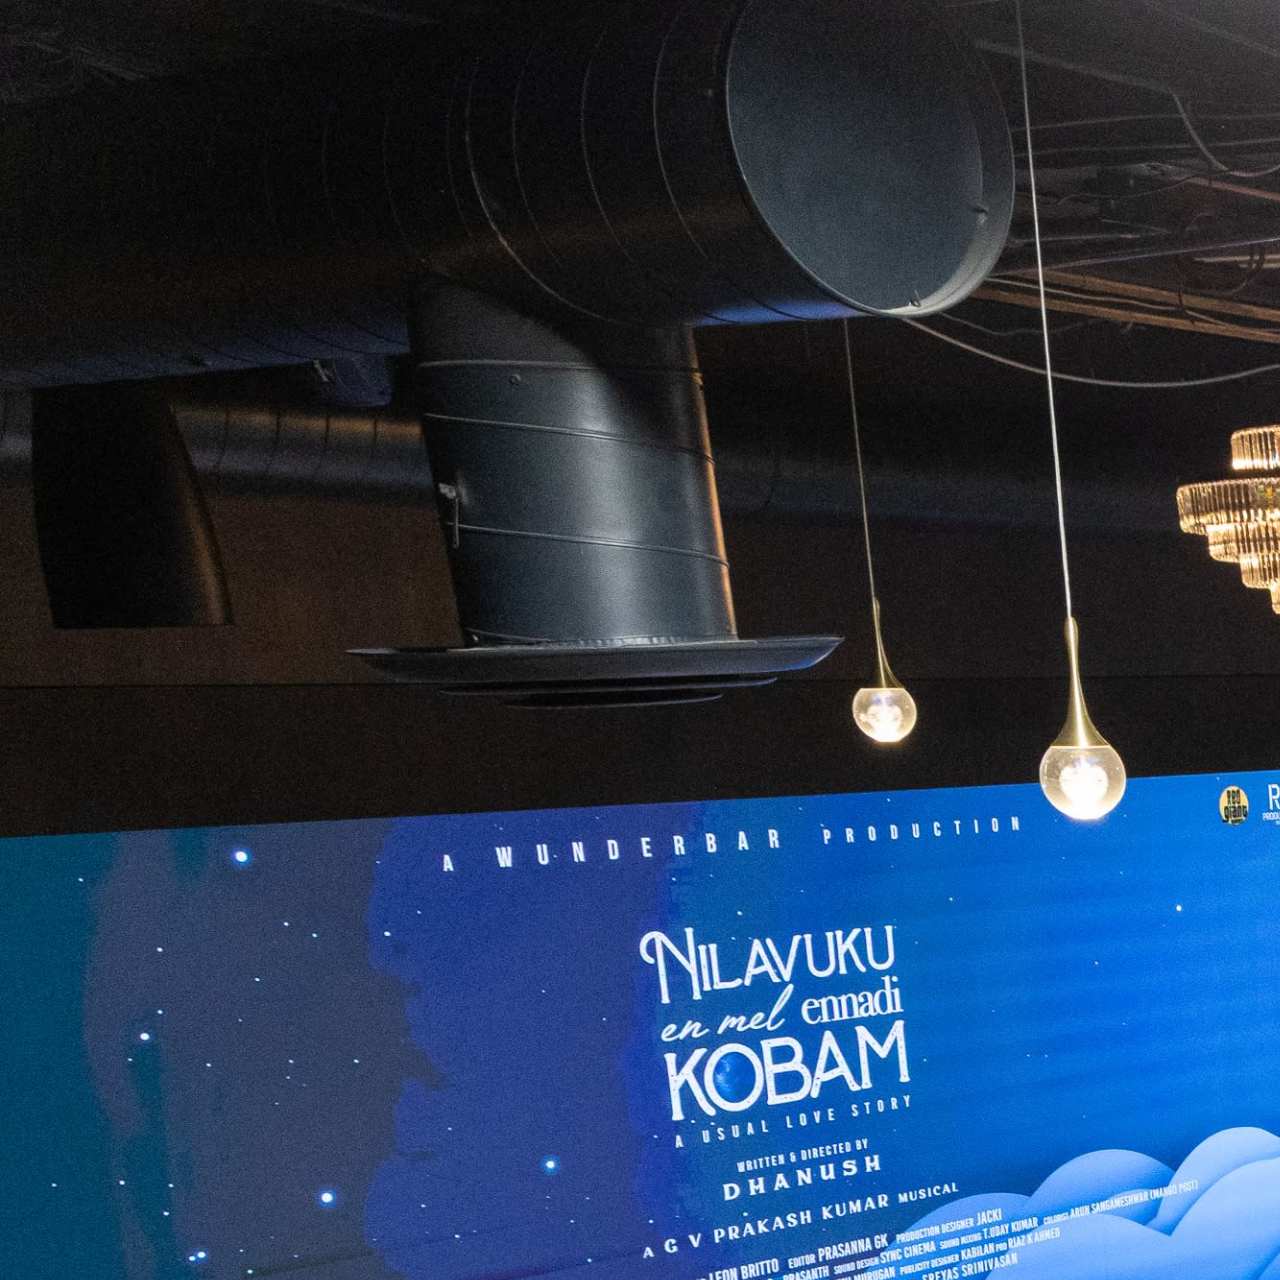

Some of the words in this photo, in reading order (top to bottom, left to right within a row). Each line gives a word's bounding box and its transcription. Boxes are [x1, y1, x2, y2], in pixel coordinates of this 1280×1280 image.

[443, 854, 454, 872] A
[495, 828, 780, 868] WUNDERBAR
[822, 816, 1020, 845] PRODUCTION
[639, 925, 896, 1004] NILAVUKU
[661, 1019, 709, 1042] en
[716, 983, 794, 1034] mel
[801, 975, 904, 1024] ennadi
[664, 1019, 910, 1121] KOBAM
[675, 1135, 684, 1148] A
[702, 1119, 769, 1143] USUAL
[786, 1108, 835, 1128] LOVE
[851, 1095, 911, 1117] STORY
[722, 1154, 881, 1201] DHANUSH
[736, 1155, 785, 1173] WRITTEN
[801, 1141, 851, 1161] DIRECTED
[855, 1138, 868, 1150] BY
[713, 1210, 812, 1243] PRAKASH
[822, 1193, 889, 1220] KUMAR
[898, 1182, 959, 1203] MUSICAL
[741, 1258, 779, 1279] BRITTO
[788, 1253, 816, 1269] EDITOR
[818, 1237, 872, 1262] PRASANNA
[874, 1234, 888, 1249] GK
[896, 1224, 940, 1244] PRODUCTION
[941, 1218, 974, 1234] DESIGNER
[977, 1208, 1002, 1226] JACKI
[880, 1249, 903, 1264] SYNC
[904, 1241, 936, 1259] CINEMA
[1011, 1216, 1038, 1233] KUMAR
[900, 1261, 930, 1276] PUBLICITY
[931, 1254, 960, 1268] DESIGNER
[961, 1252, 1018, 1278] SRINIVASAN
